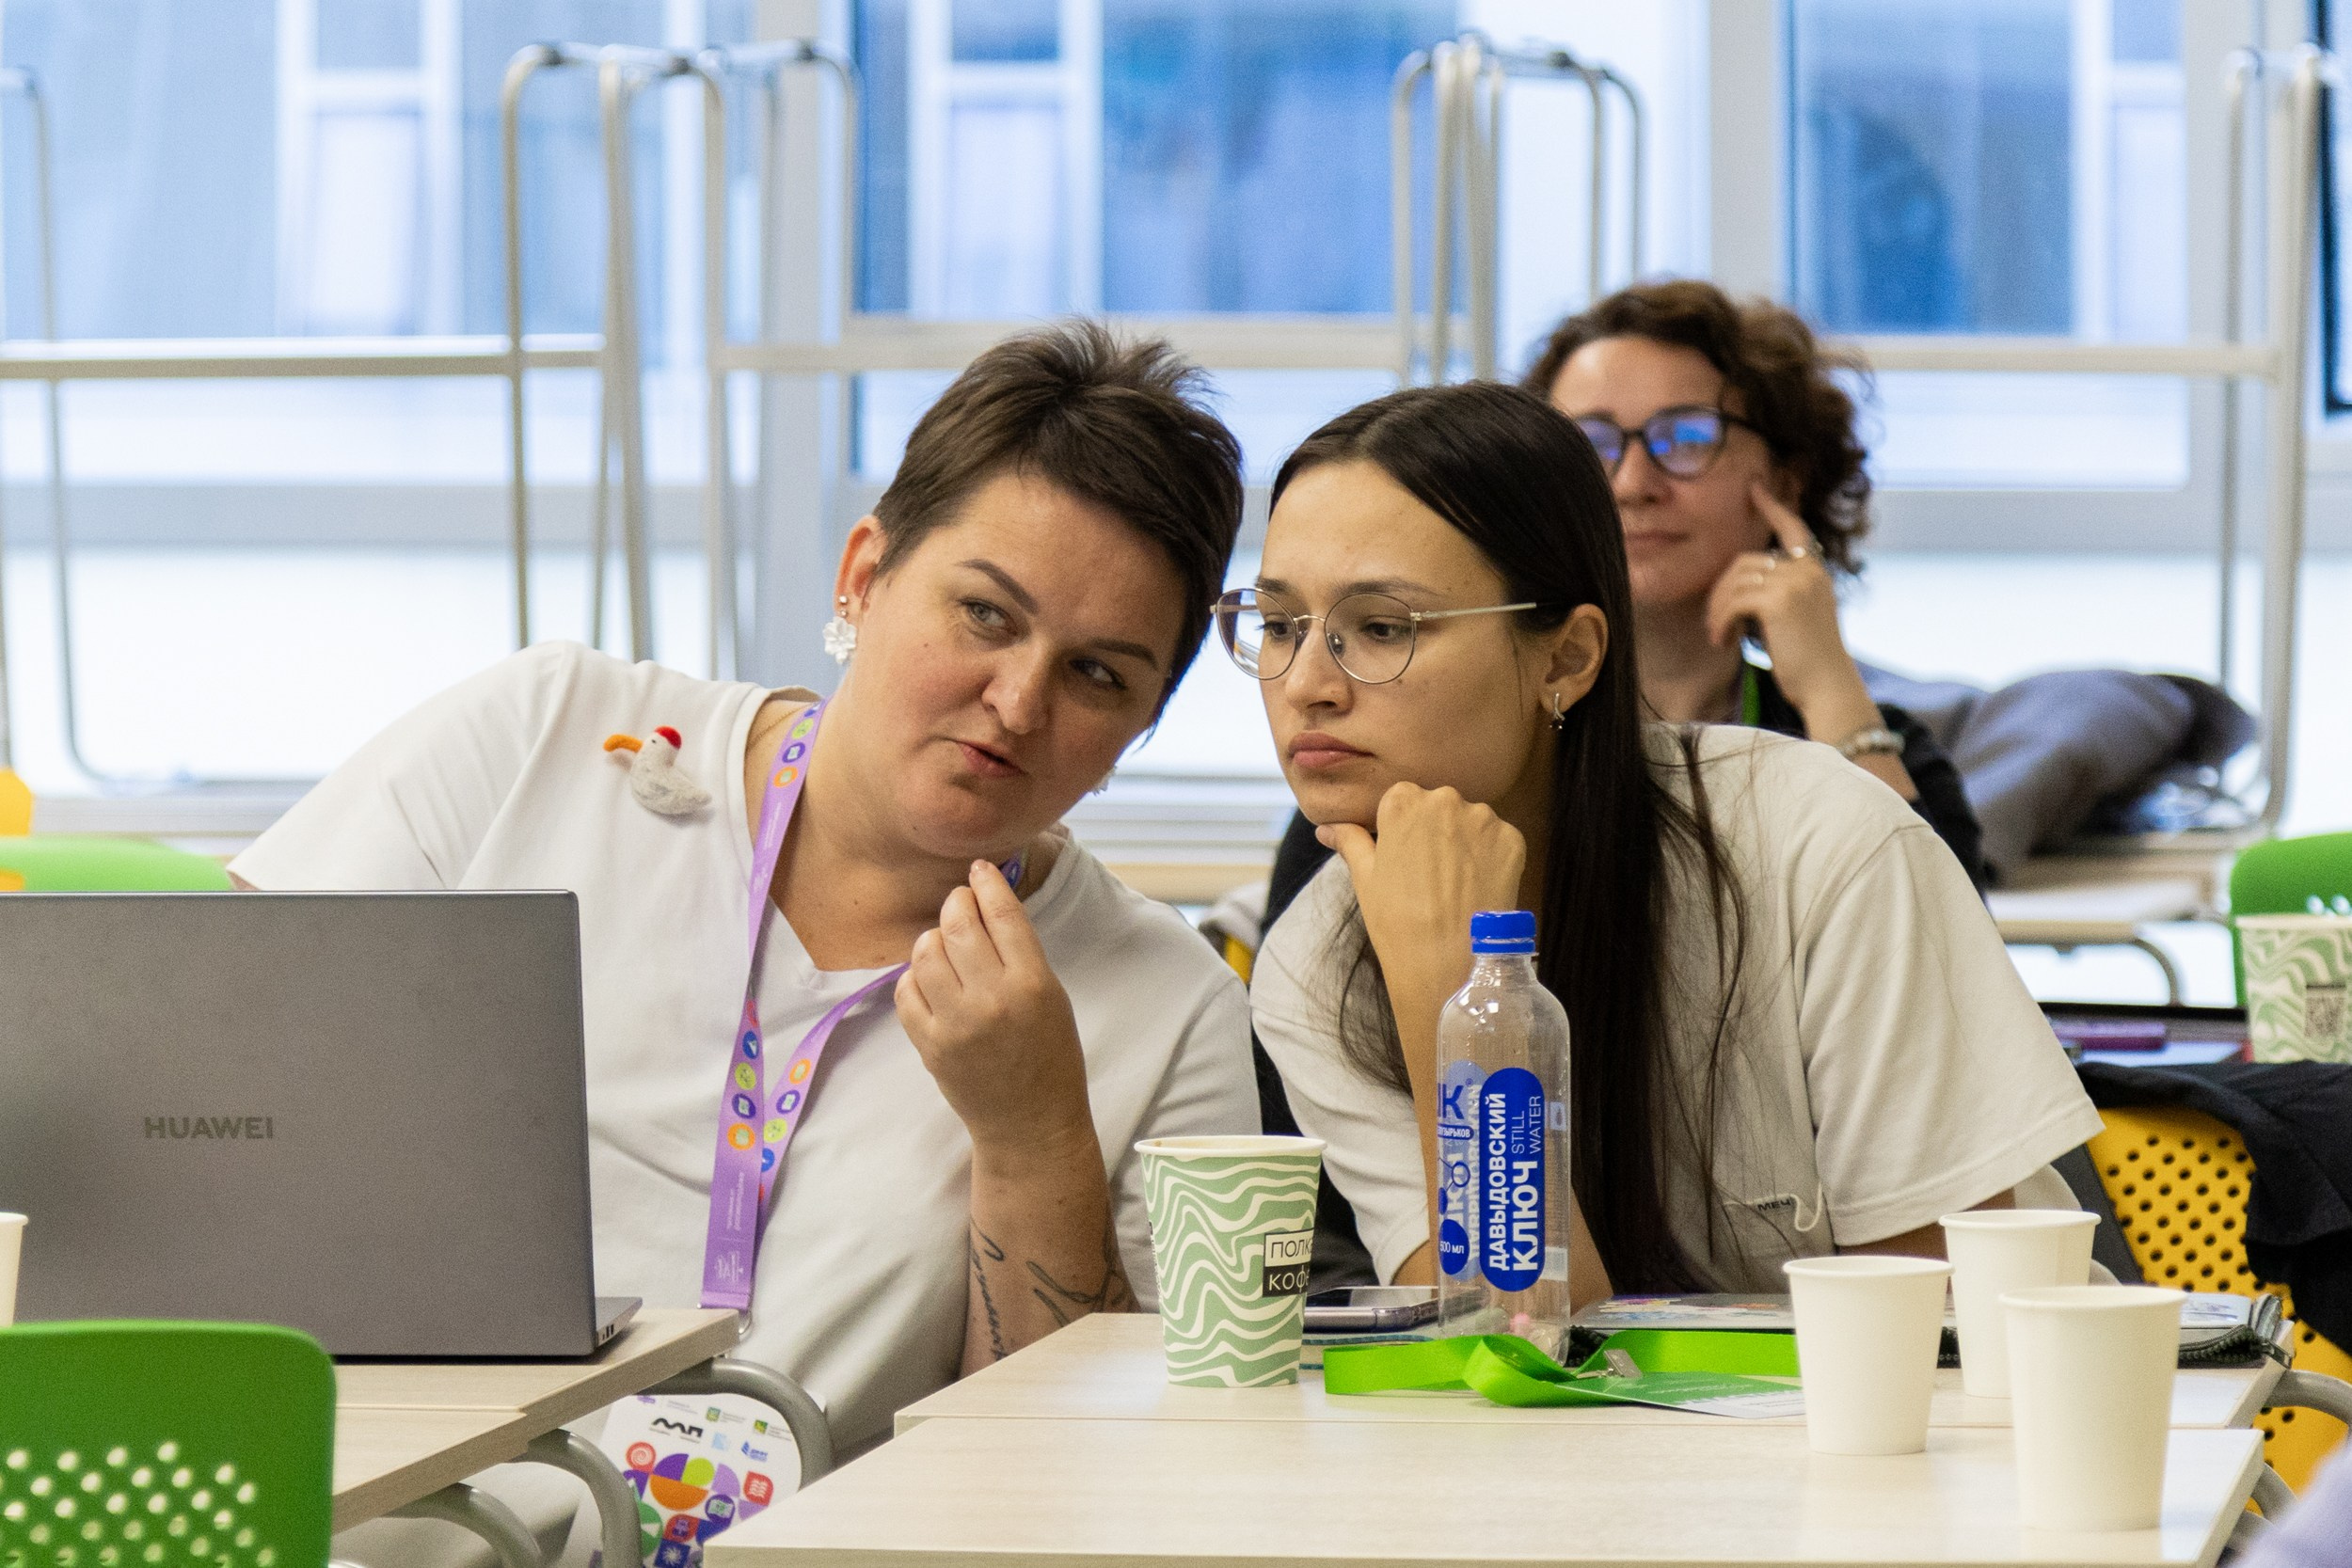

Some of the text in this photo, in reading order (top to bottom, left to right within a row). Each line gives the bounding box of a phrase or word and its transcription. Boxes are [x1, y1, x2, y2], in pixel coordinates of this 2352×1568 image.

[144, 1117, 274, 1139] HUAWEI
[1511, 1110, 1525, 1155] STILL
[1529, 1095, 1542, 1155] WATER
[1485, 1093, 1510, 1271] ДАВЫДОВСКИЙ
[1513, 1161, 1539, 1271] КЛЮЧ
[1270, 1237, 1312, 1259] ПОЛК
